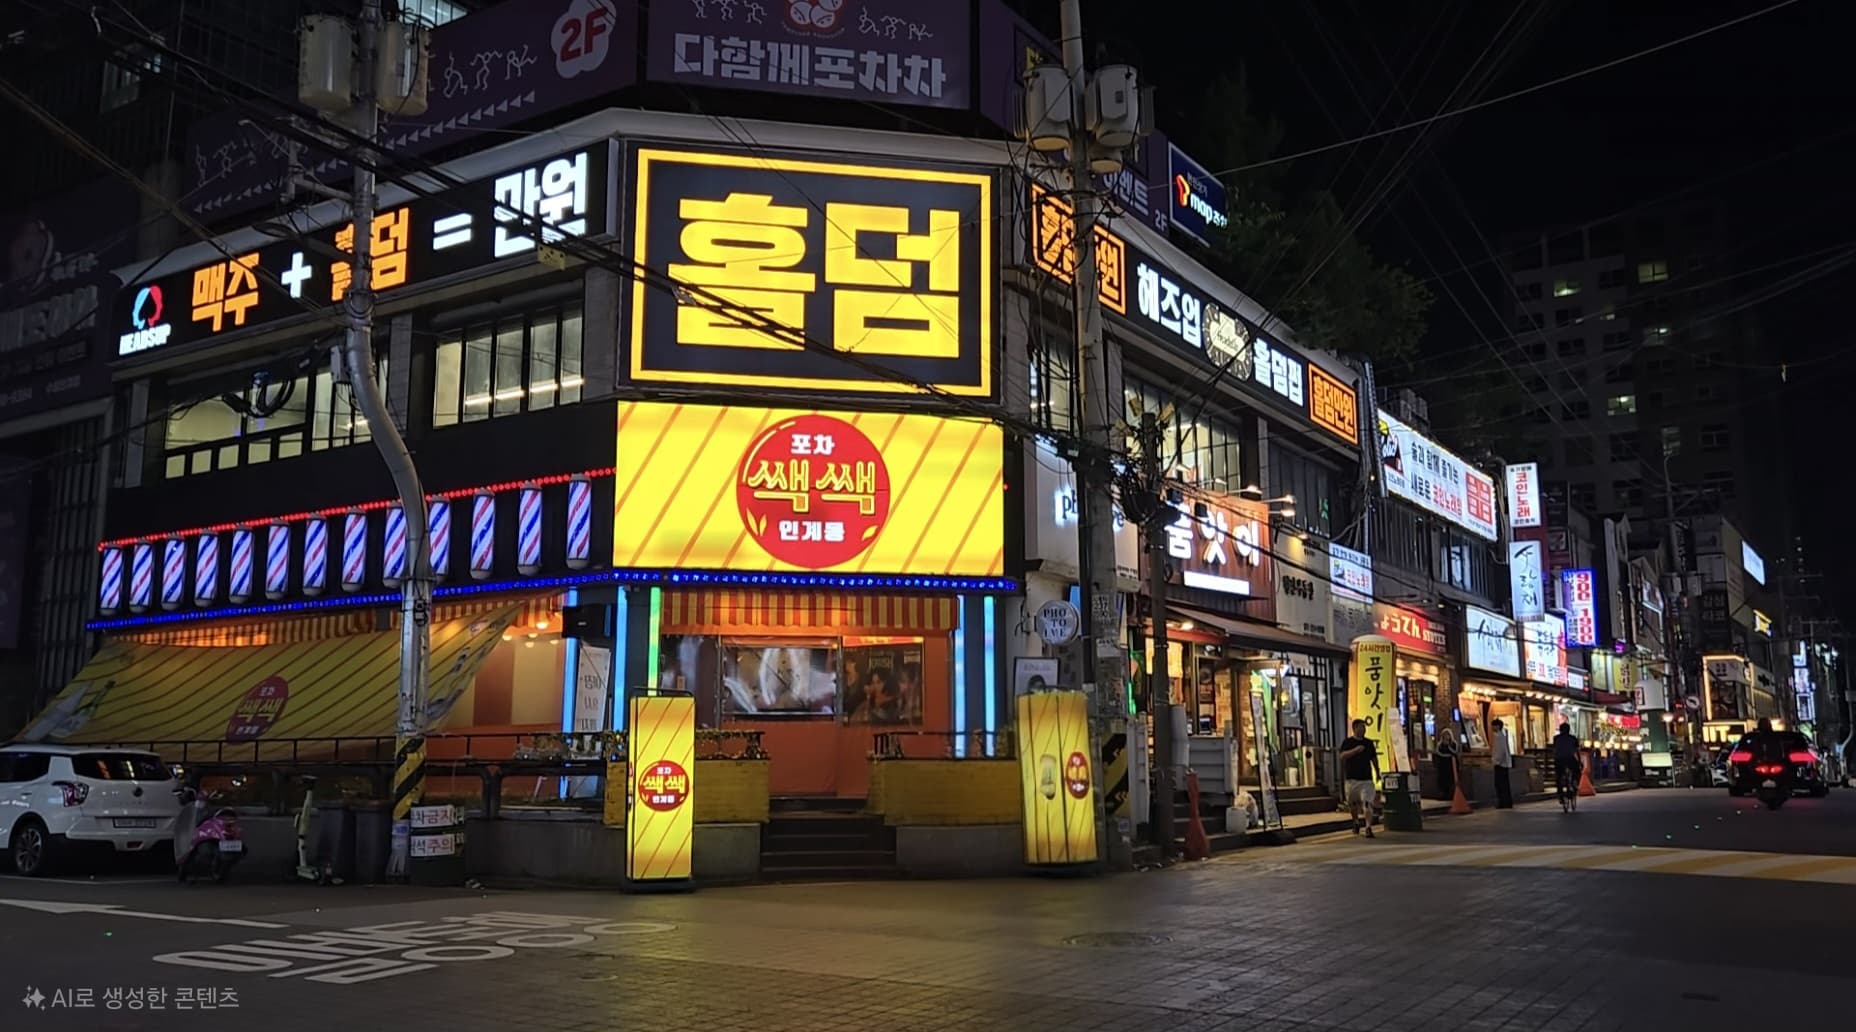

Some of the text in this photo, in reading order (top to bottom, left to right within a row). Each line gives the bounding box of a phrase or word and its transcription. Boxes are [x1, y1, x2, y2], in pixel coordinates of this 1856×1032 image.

[561, 7, 608, 62] 2F
[674, 32, 947, 98] 다함께포차차
[191, 253, 260, 332] 맥주
[494, 151, 588, 258] 만원
[1155, 208, 1168, 232] 2F
[667, 193, 960, 359] 홀덤
[1137, 261, 1304, 407] 헤즈업 홀덤펍
[1313, 374, 1355, 437] 홀덤만원
[790, 433, 835, 456] 포차
[779, 519, 846, 543] 인계동
[1043, 608, 1068, 618] PHO
[1051, 618, 1068, 627] TO
